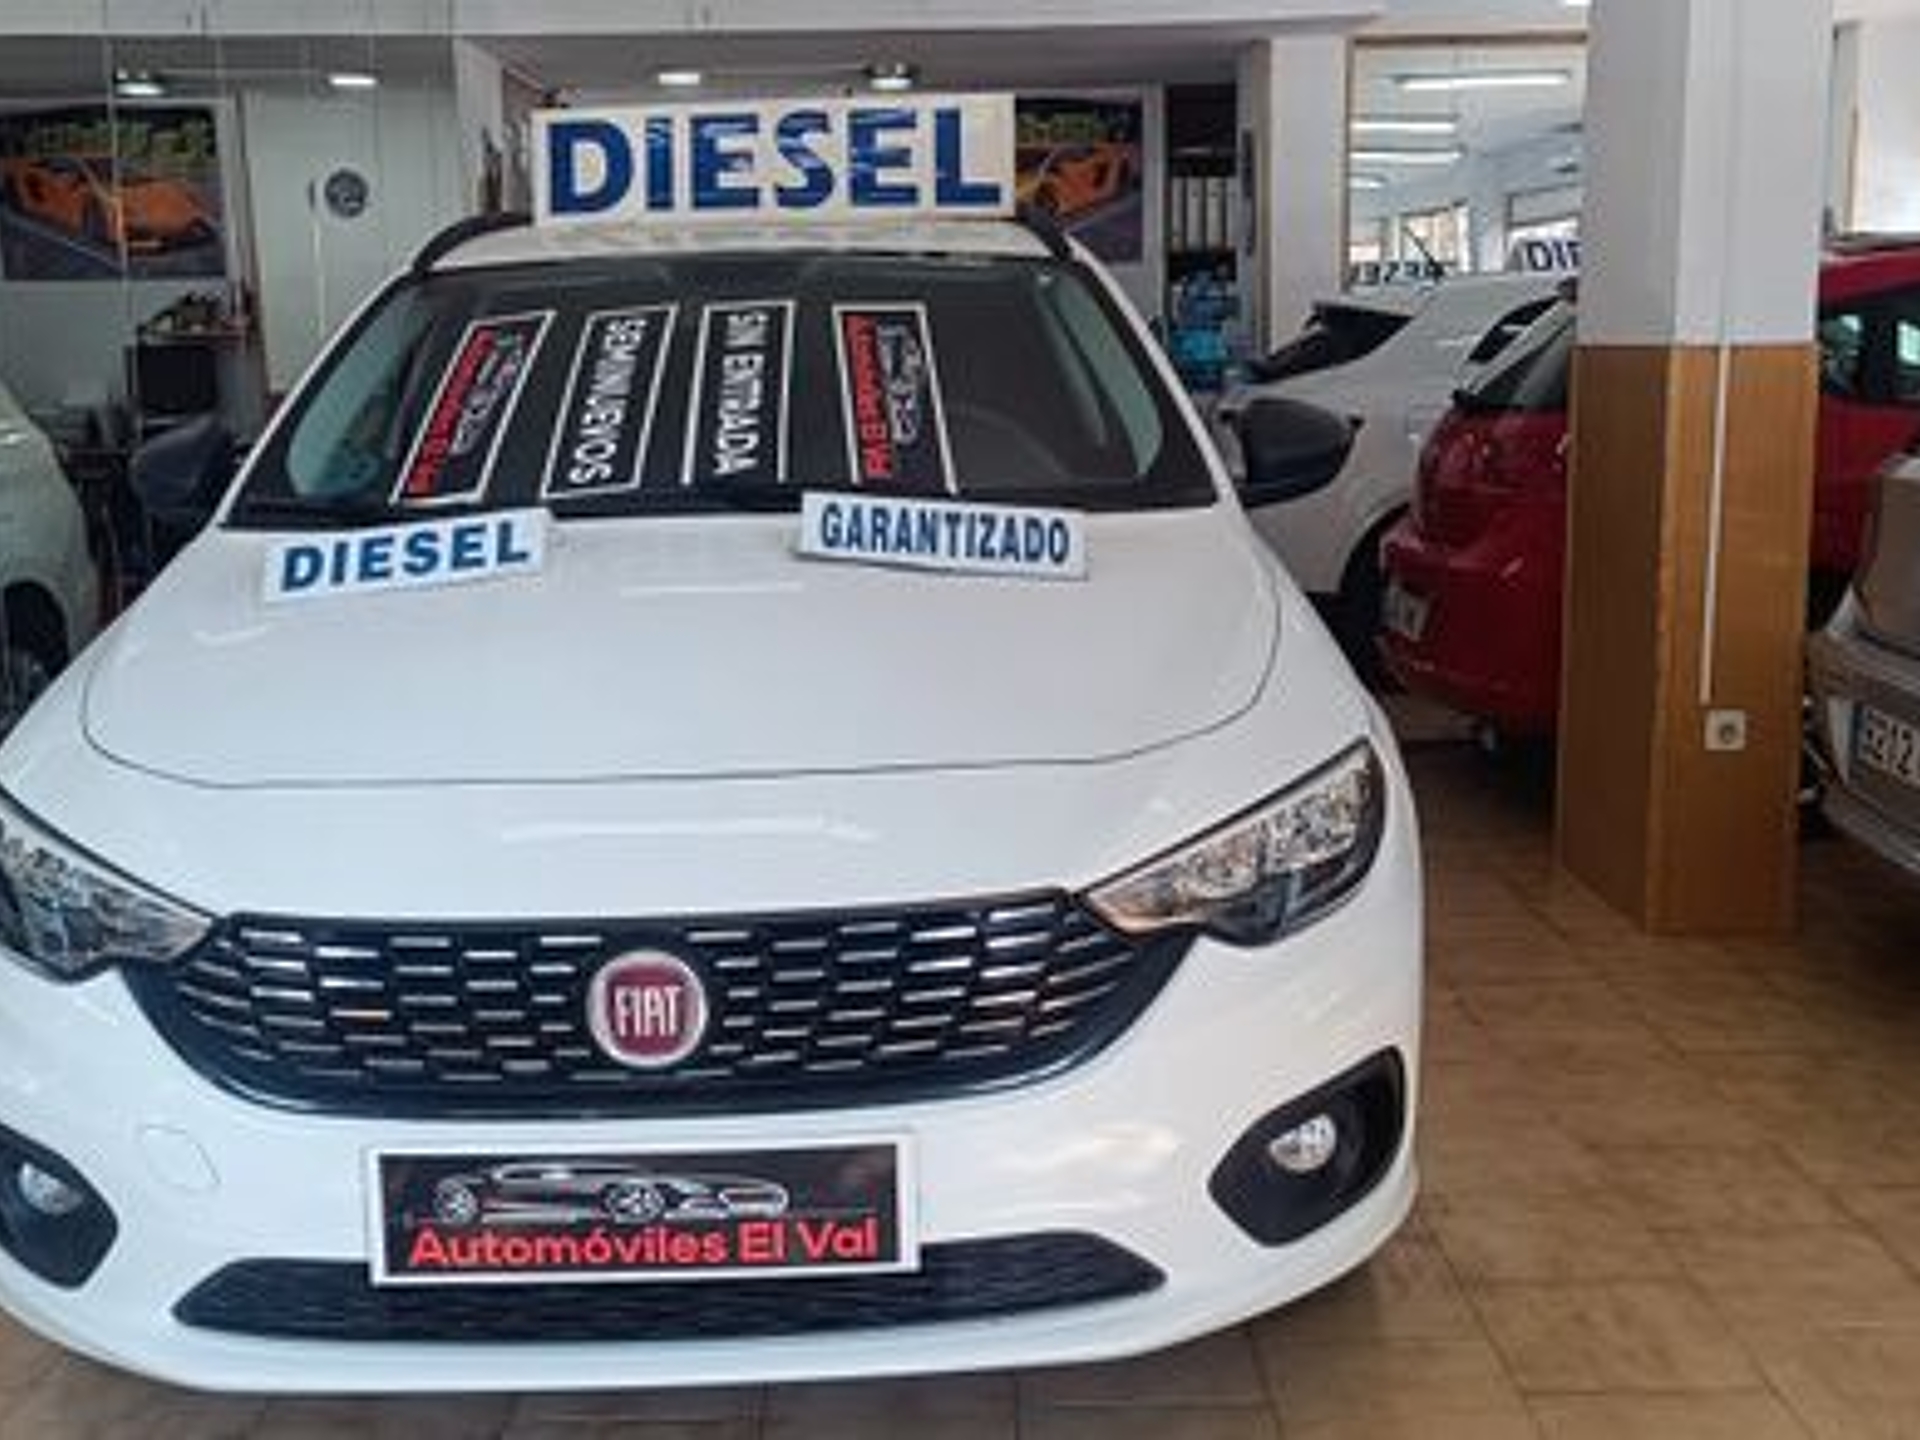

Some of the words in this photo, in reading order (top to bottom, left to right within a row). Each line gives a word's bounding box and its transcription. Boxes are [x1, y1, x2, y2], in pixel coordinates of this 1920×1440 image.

[548, 108, 1001, 214] DIESEL
[713, 353, 764, 476] ENTRADA
[281, 520, 529, 592] DIESEL
[821, 502, 1070, 564] GARANTIZADO
[615, 986, 681, 1037] FIAT
[410, 1225, 728, 1267] Automóviles
[739, 1222, 785, 1262] El
[797, 1217, 879, 1260] Val
